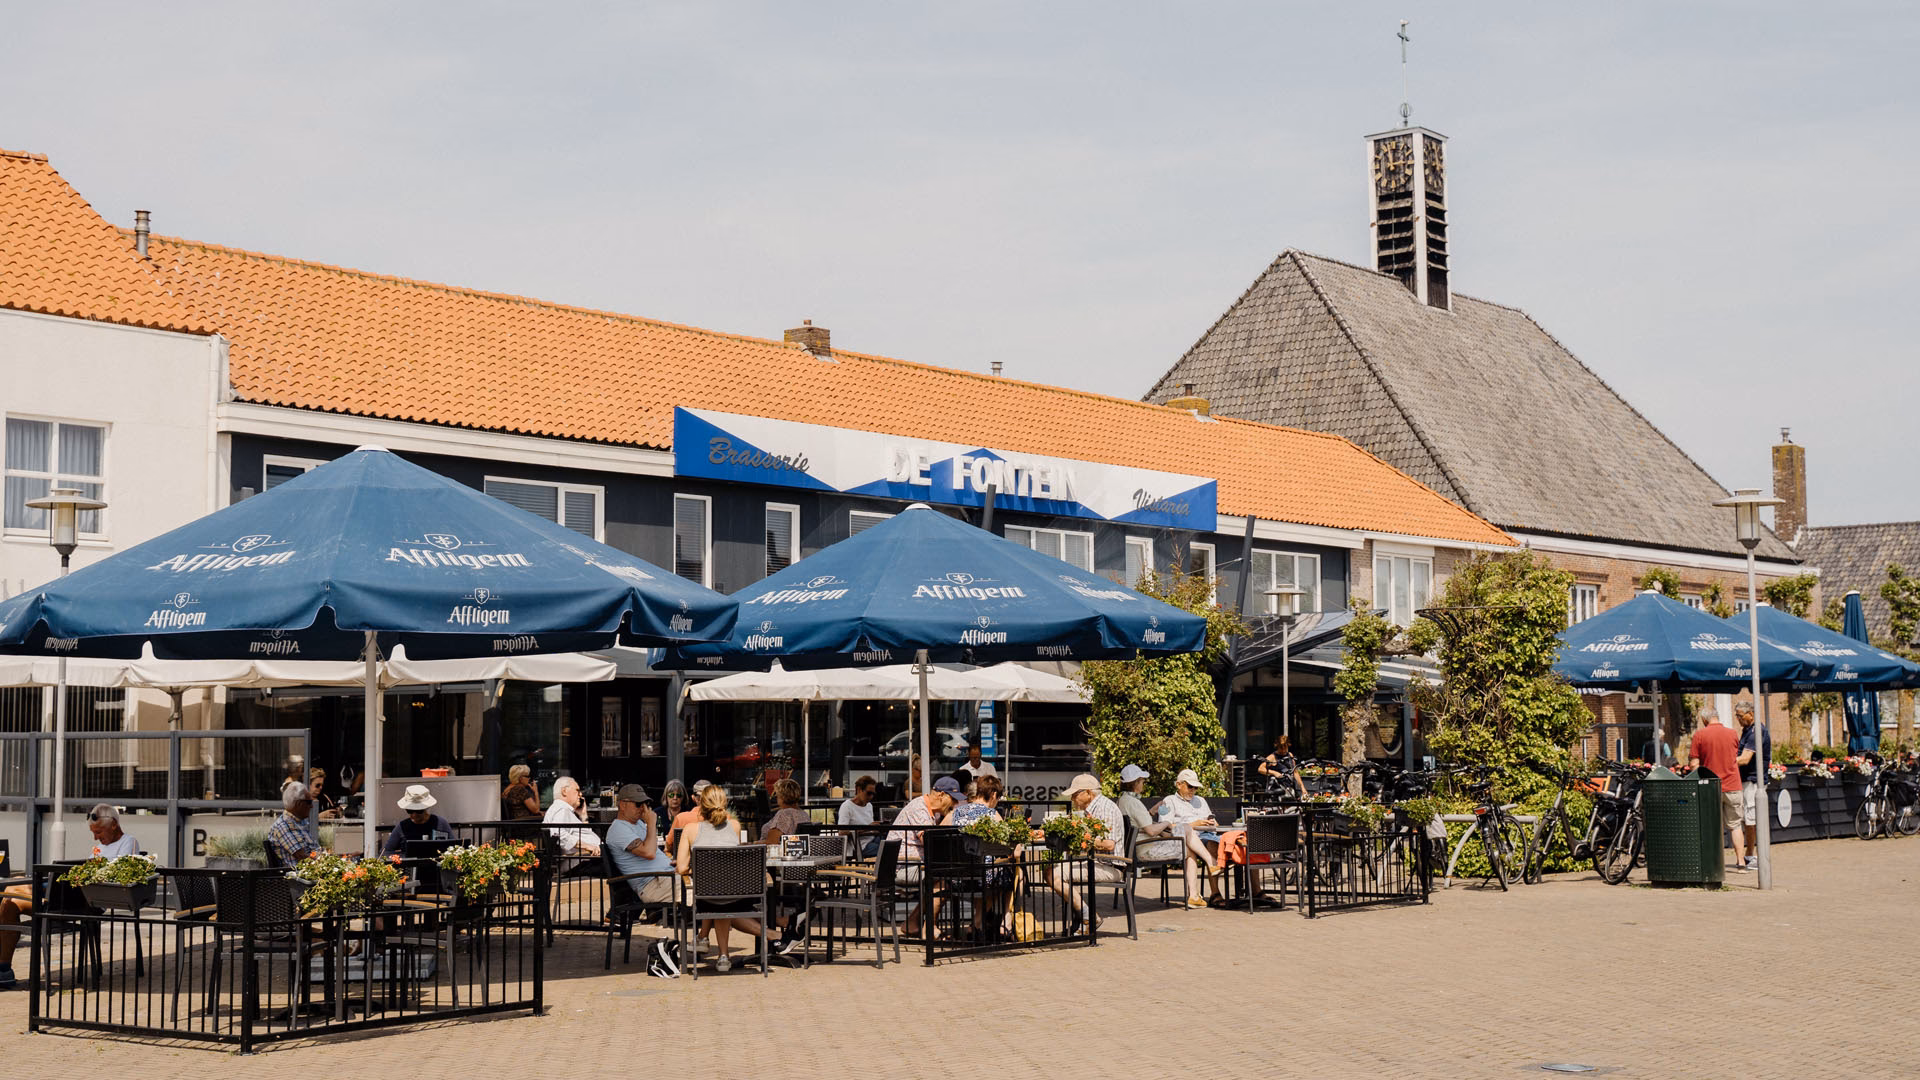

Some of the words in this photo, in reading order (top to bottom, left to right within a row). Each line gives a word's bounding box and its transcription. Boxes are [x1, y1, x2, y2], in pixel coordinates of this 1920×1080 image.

[708, 436, 809, 473] Brasserie
[885, 448, 932, 486] DE
[952, 455, 1078, 502] FONTEIN
[145, 550, 296, 573] Affligem
[385, 547, 533, 570] Affligem
[743, 588, 849, 605] Affligem
[911, 584, 1027, 601] Affligem
[144, 609, 206, 630] Affligem
[447, 605, 510, 627] Affligem
[743, 634, 783, 651] Affligem
[958, 629, 1007, 646] Affligem
[1579, 642, 1649, 653] Affligem
[1591, 668, 1620, 679] Affligem
